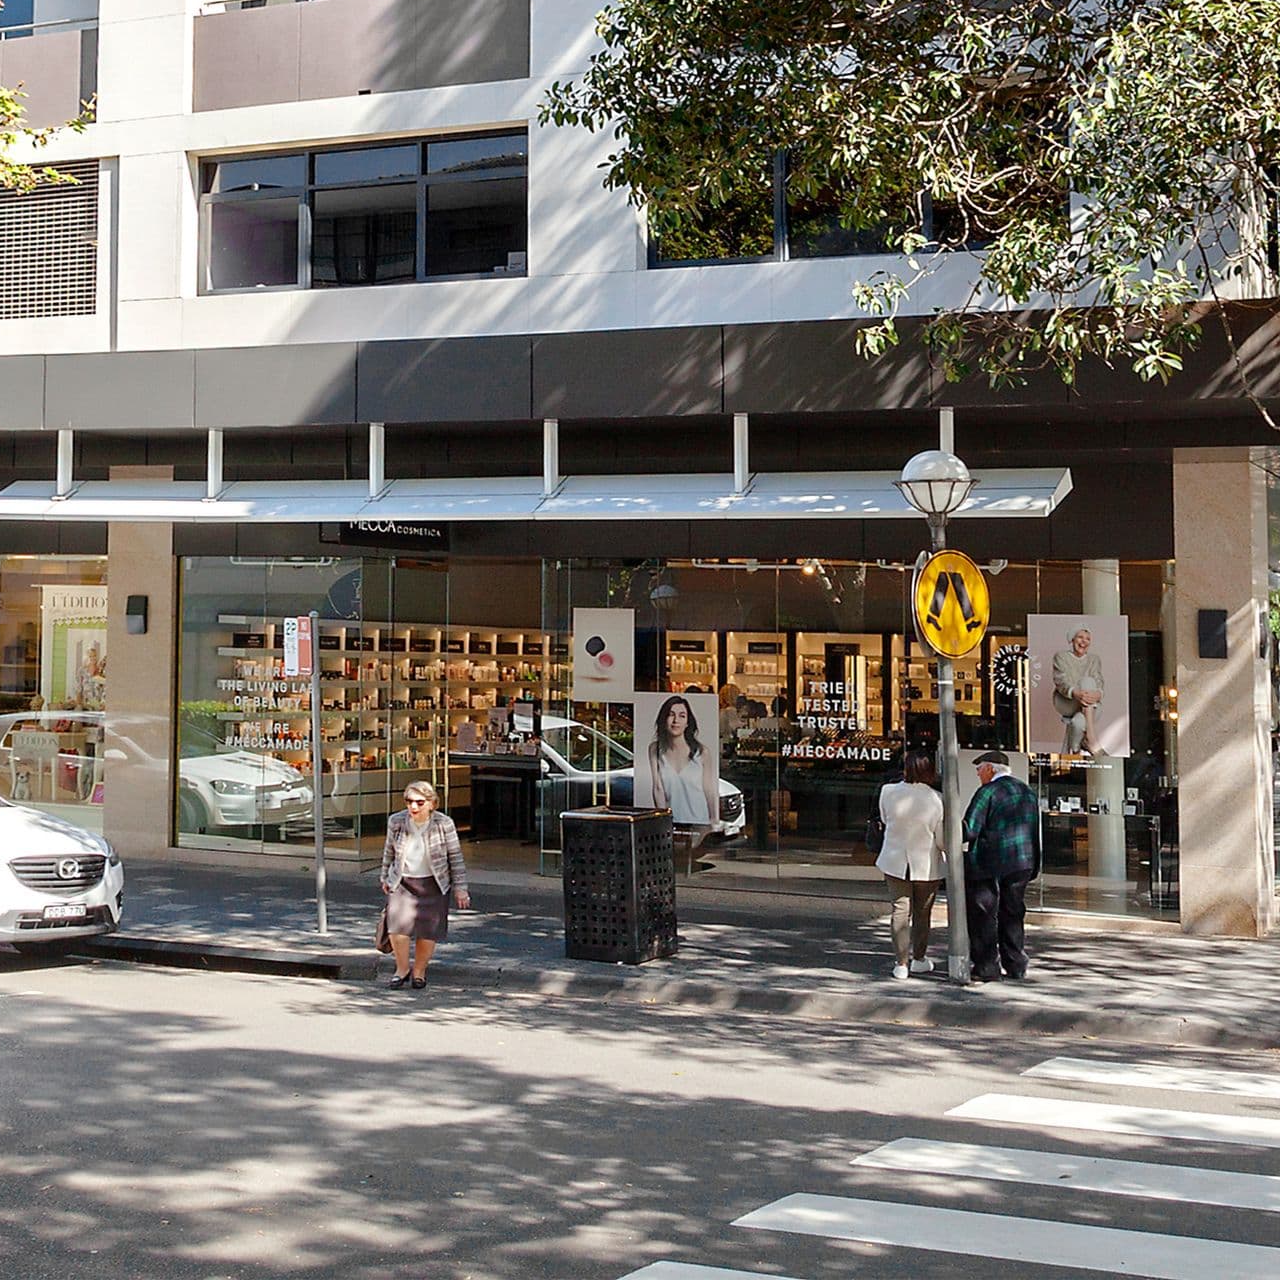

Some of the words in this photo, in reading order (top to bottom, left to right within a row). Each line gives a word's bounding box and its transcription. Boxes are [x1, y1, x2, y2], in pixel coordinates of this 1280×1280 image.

[349, 519, 396, 533] MECCA
[397, 525, 441, 537] COSMETICA
[221, 680, 243, 691] THE
[247, 681, 288, 693] LIVING
[234, 695, 249, 706] OF
[253, 696, 302, 709] BEAUTY
[266, 722, 290, 734] ARE
[225, 735, 310, 751] #MECCAMADE
[781, 744, 891, 761] #MECCAMADE
